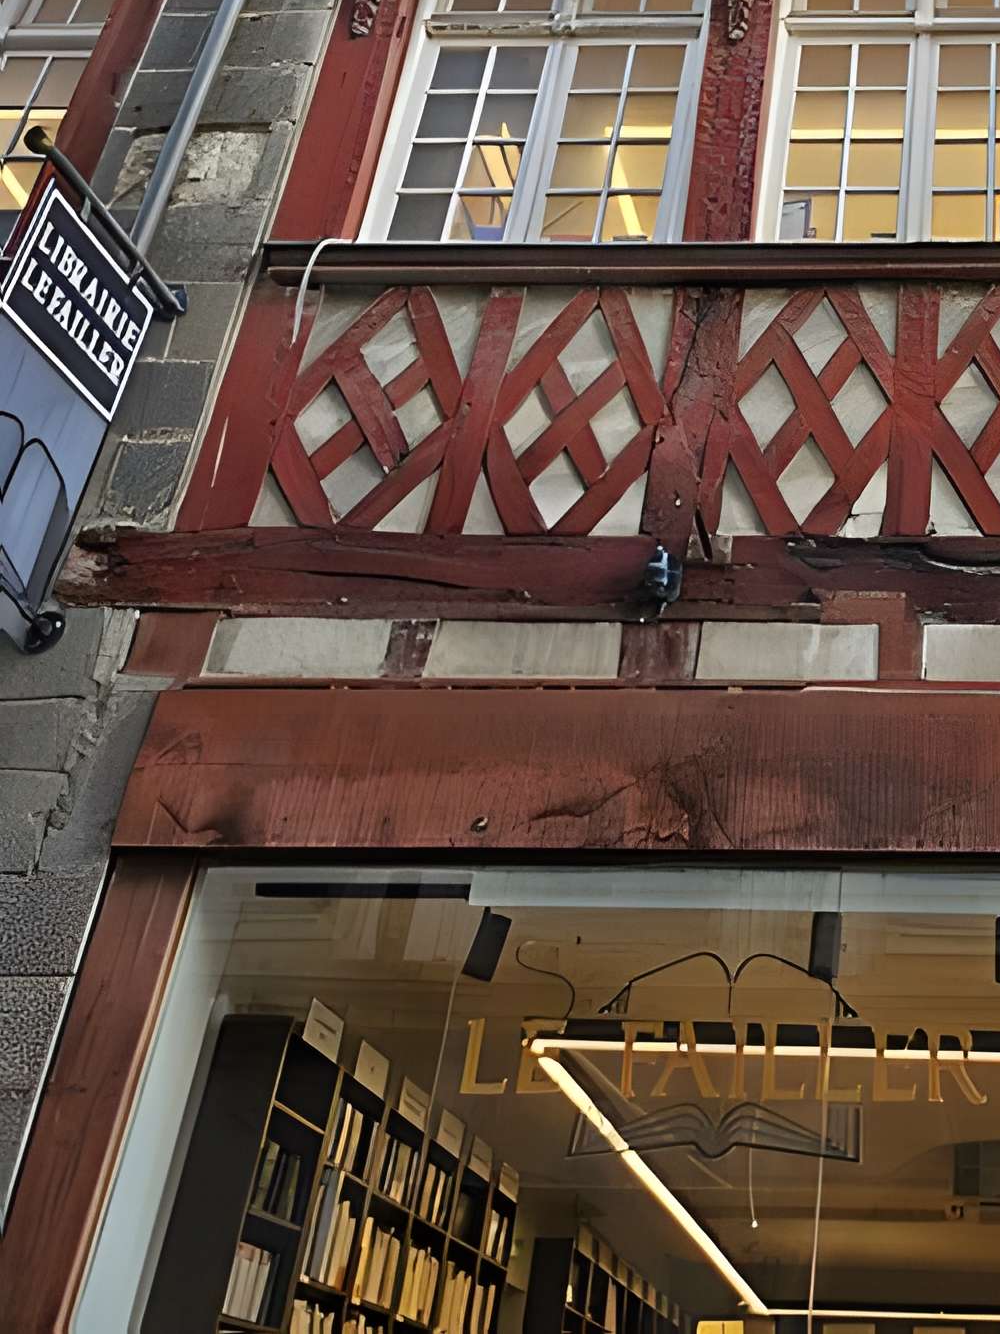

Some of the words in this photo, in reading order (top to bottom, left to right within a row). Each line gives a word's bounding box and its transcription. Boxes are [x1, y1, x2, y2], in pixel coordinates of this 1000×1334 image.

[21, 257, 53, 305] LE
[46, 286, 125, 387] FAILLER
[38, 221, 140, 351] LIBRAIRIE
[460, 1017, 567, 1094] LE
[620, 1019, 988, 1105] FAILLER
